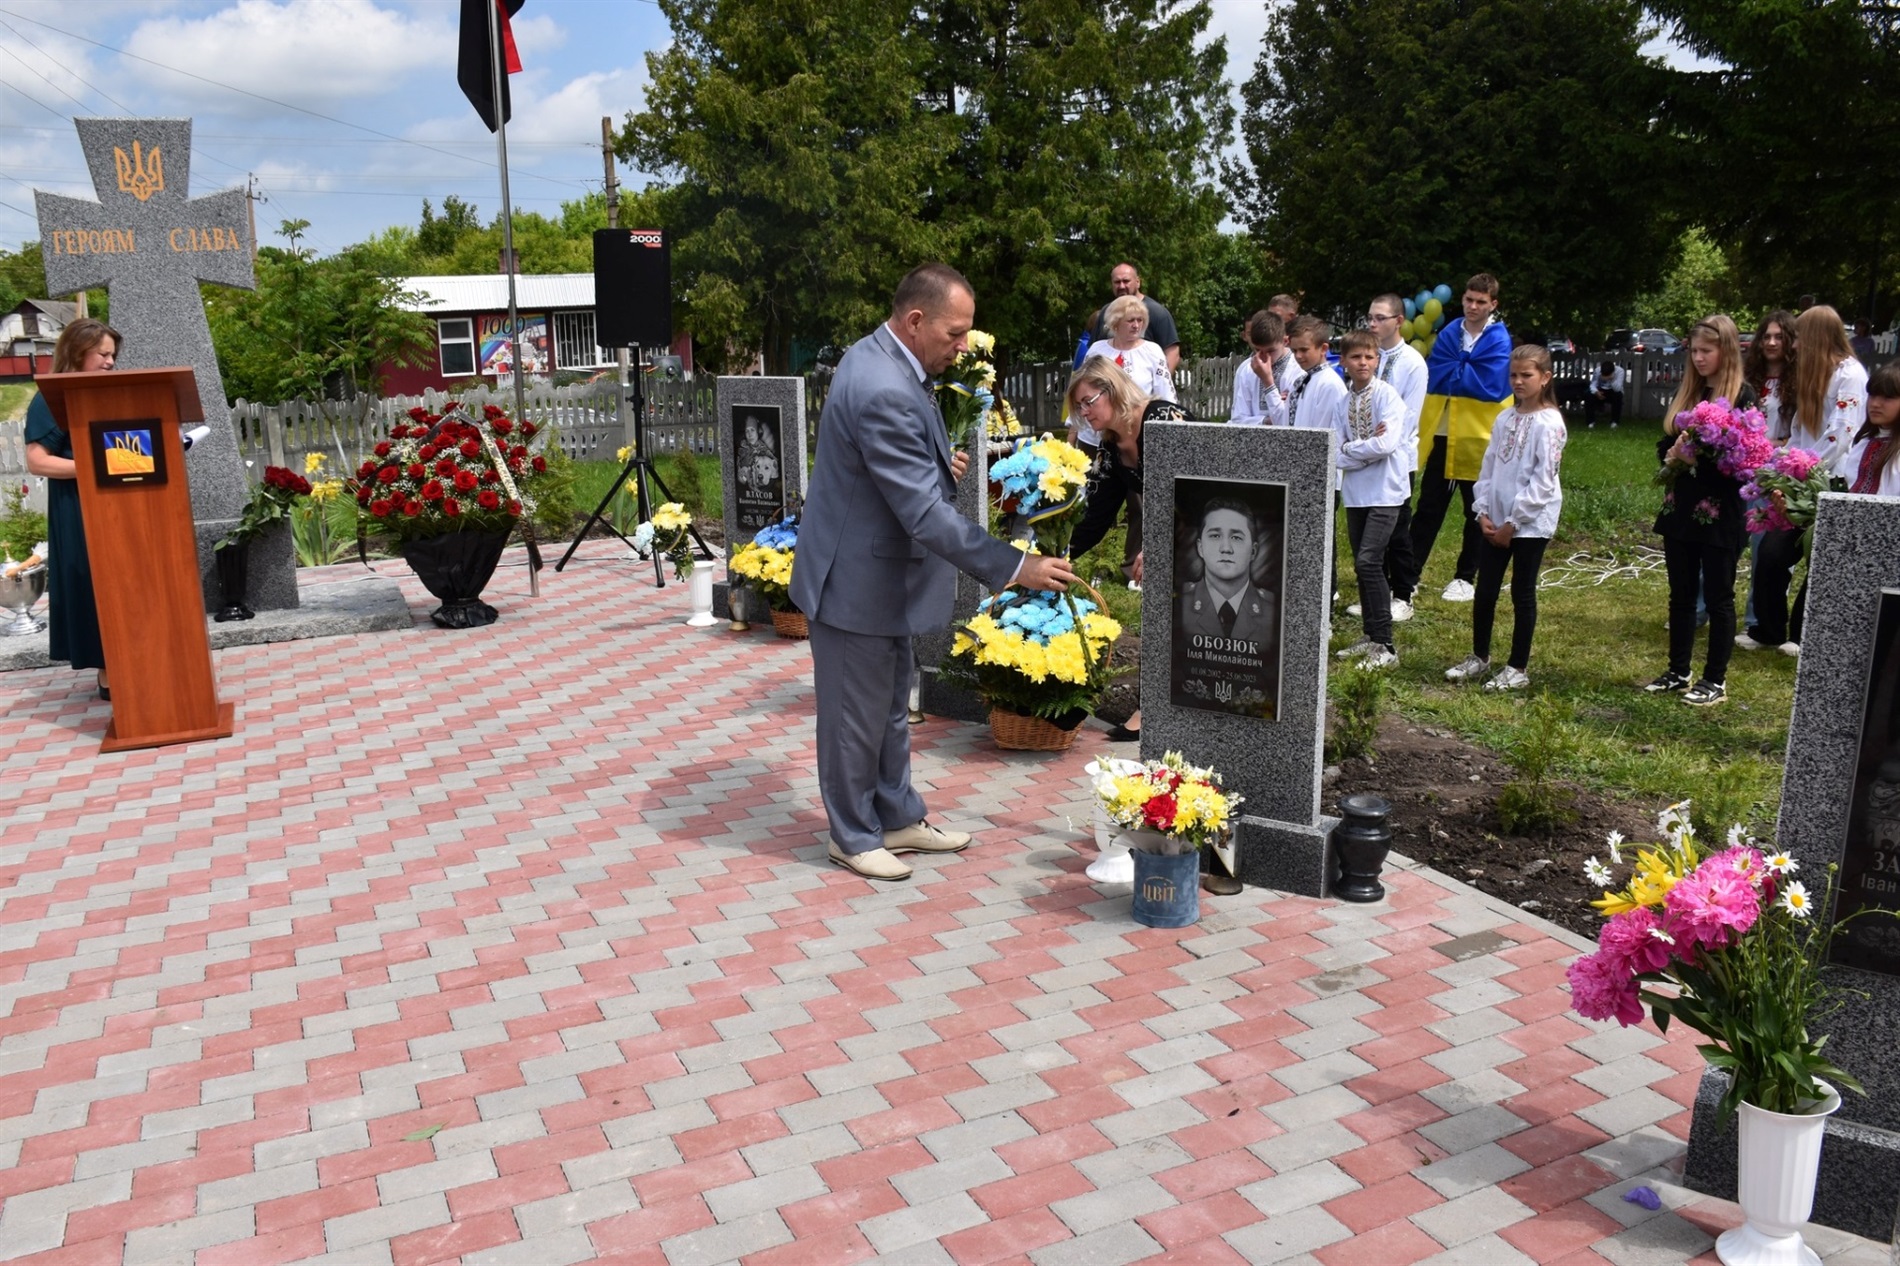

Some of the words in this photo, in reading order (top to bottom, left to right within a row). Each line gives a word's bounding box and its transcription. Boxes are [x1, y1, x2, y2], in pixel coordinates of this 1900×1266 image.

[52, 229, 136, 255] ГЕРОЯМ
[169, 227, 240, 252] СЛАВА
[630, 235, 660, 243] 2000
[482, 315, 526, 335] 1000
[1192, 634, 1259, 655] ОБОЗЮК
[1186, 648, 1203, 660] Ілля
[1205, 650, 1263, 668] Миколайович
[1861, 872, 1897, 894] Іван
